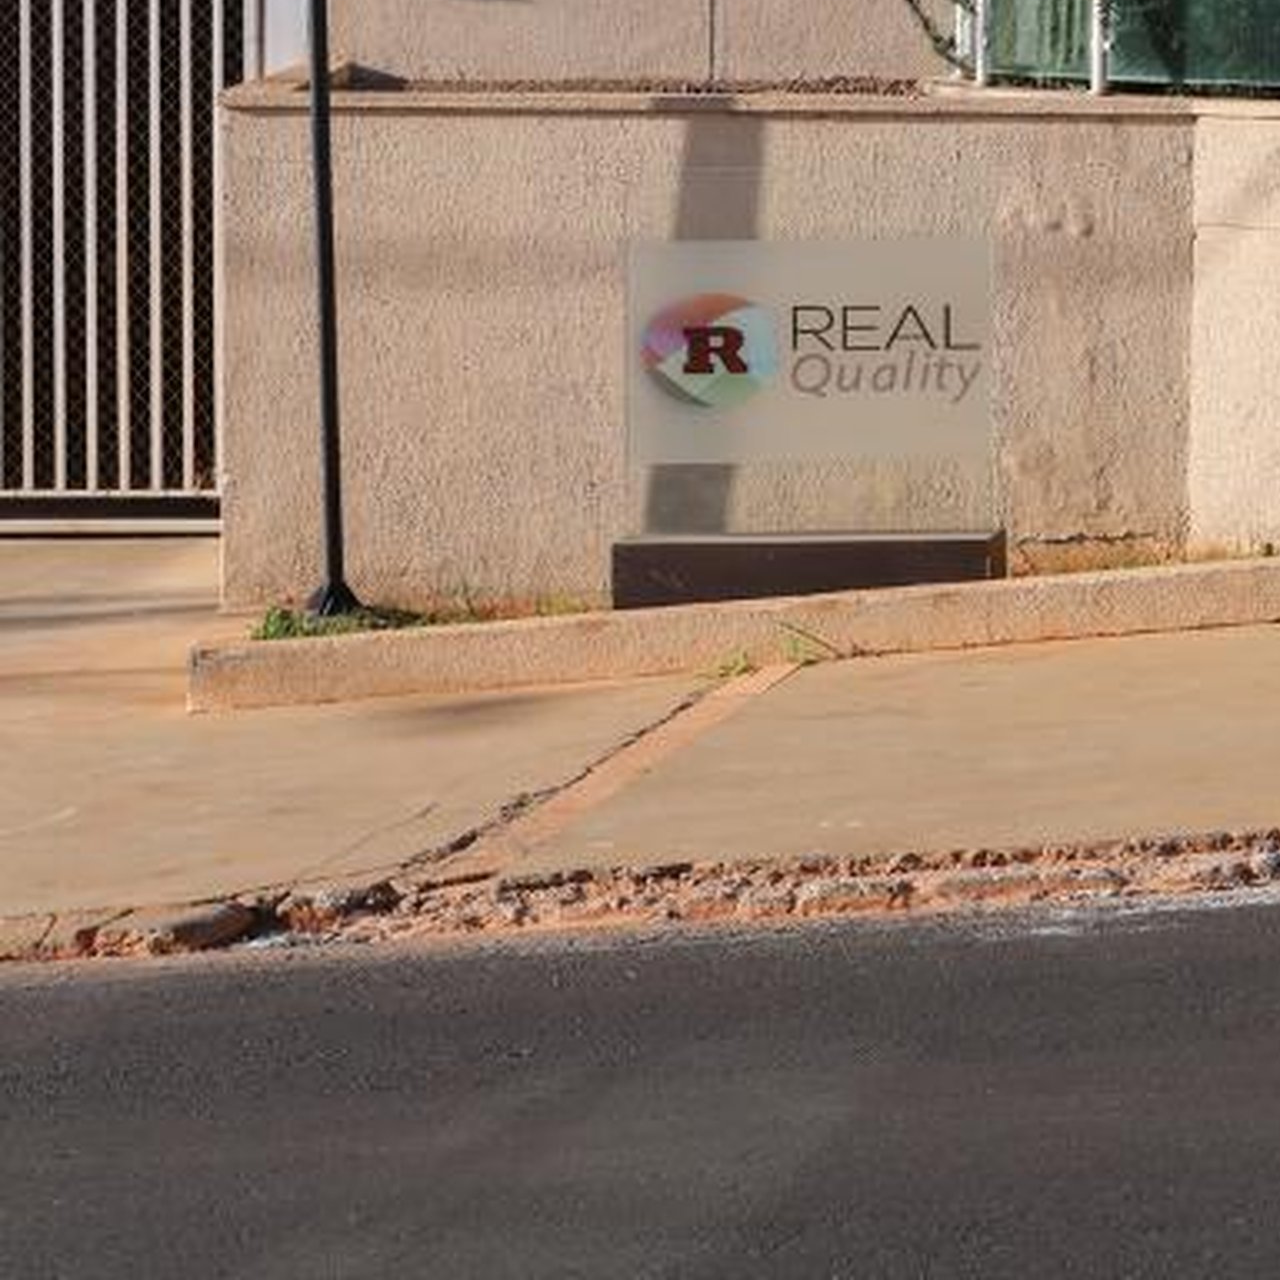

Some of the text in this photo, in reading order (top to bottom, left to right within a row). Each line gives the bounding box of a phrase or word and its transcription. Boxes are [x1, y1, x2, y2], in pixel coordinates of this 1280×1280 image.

[682, 325, 748, 375] R
[792, 304, 982, 351] REAL
[791, 351, 982, 404] Quality
